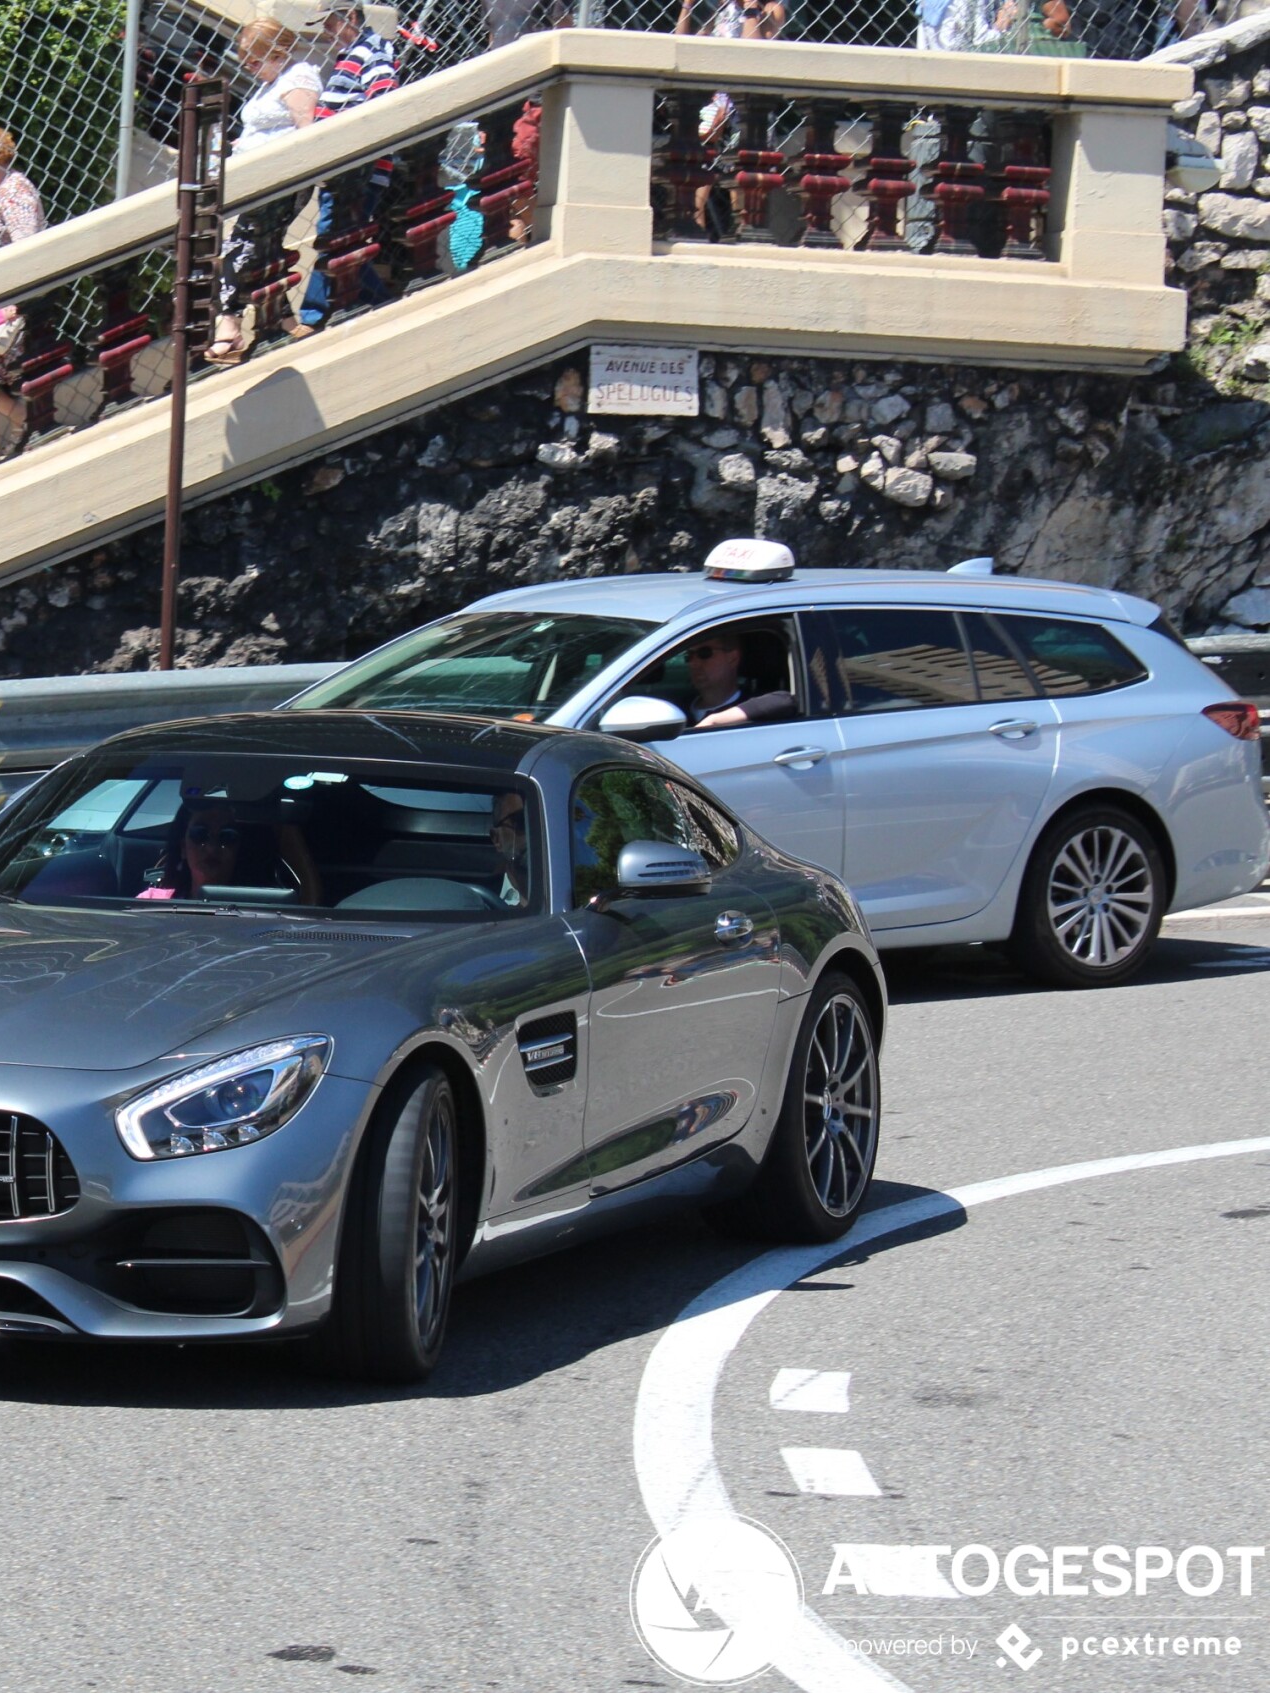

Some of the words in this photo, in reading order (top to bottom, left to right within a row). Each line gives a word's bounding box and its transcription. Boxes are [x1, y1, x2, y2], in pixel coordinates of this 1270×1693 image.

[605, 360, 655, 374] AVENUE
[660, 362, 685, 375] DES
[596, 383, 693, 403] SPELUGUES
[722, 547, 755, 559] TAXI
